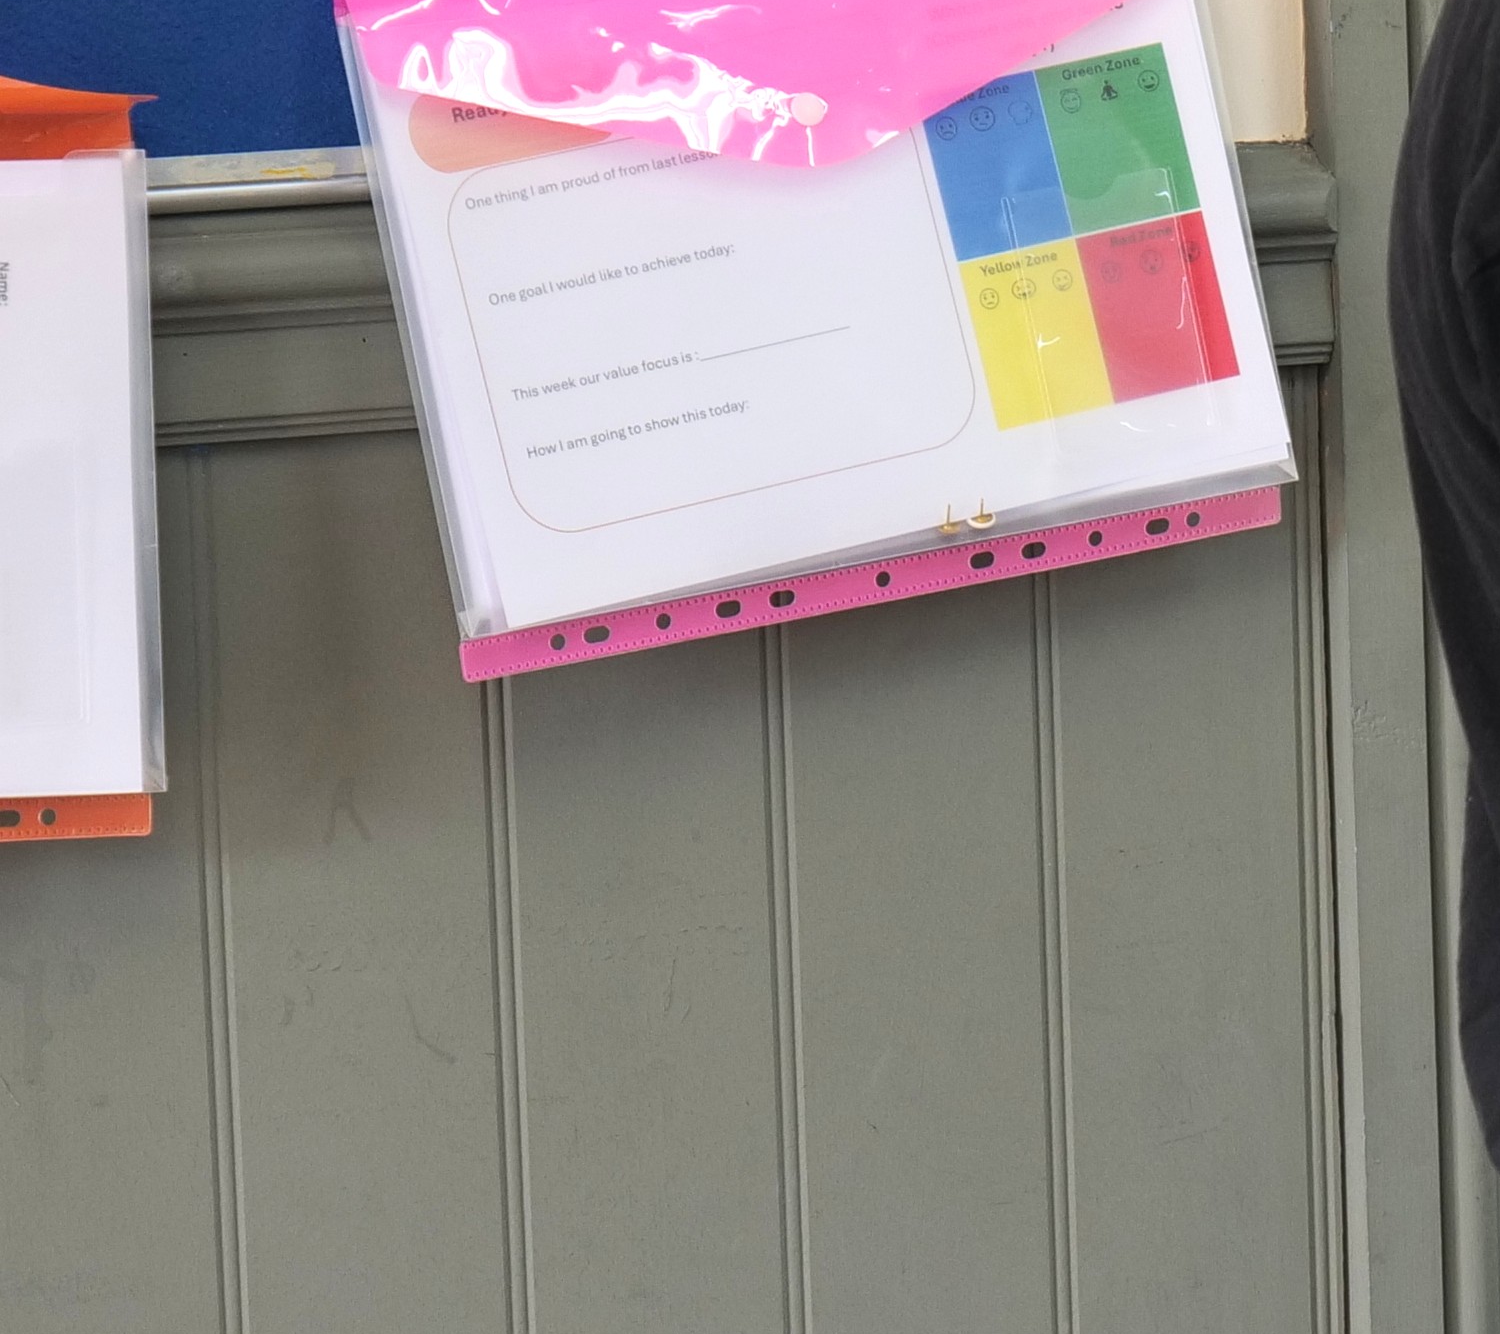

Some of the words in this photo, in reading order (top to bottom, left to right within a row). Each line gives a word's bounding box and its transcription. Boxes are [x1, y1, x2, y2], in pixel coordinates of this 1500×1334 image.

[1061, 63, 1104, 83] Green
[1105, 54, 1142, 73] Zone
[977, 81, 1011, 100] Zone
[465, 196, 493, 211] One
[494, 187, 529, 204] thing
[530, 185, 536, 197] I
[536, 182, 560, 196] am
[561, 171, 601, 193] proud
[603, 168, 617, 182] of
[617, 161, 651, 179] from
[651, 156, 678, 171] last
[1135, 223, 1174, 242] Zone
[488, 291, 517, 307] One
[518, 281, 548, 301] goal
[549, 281, 556, 293] I
[556, 273, 597, 291] would
[599, 266, 623, 282] like
[625, 263, 640, 277] to
[641, 251, 692, 274] achieve
[693, 243, 736, 263] today:
[979, 258, 1022, 278] Yellow
[1024, 250, 1059, 269] Zone
[511, 385, 540, 402] This
[541, 377, 578, 396] week
[578, 372, 602, 388] our
[602, 364, 640, 383] value
[640, 355, 680, 375] focus
[680, 351, 695, 365] is
[526, 442, 558, 460] How
[559, 439, 565, 452] I
[566, 436, 589, 452] am
[590, 426, 628, 448] going
[628, 423, 643, 437] to
[644, 414, 681, 434] show
[681, 407, 707, 424] this
[708, 398, 750, 418] today:
